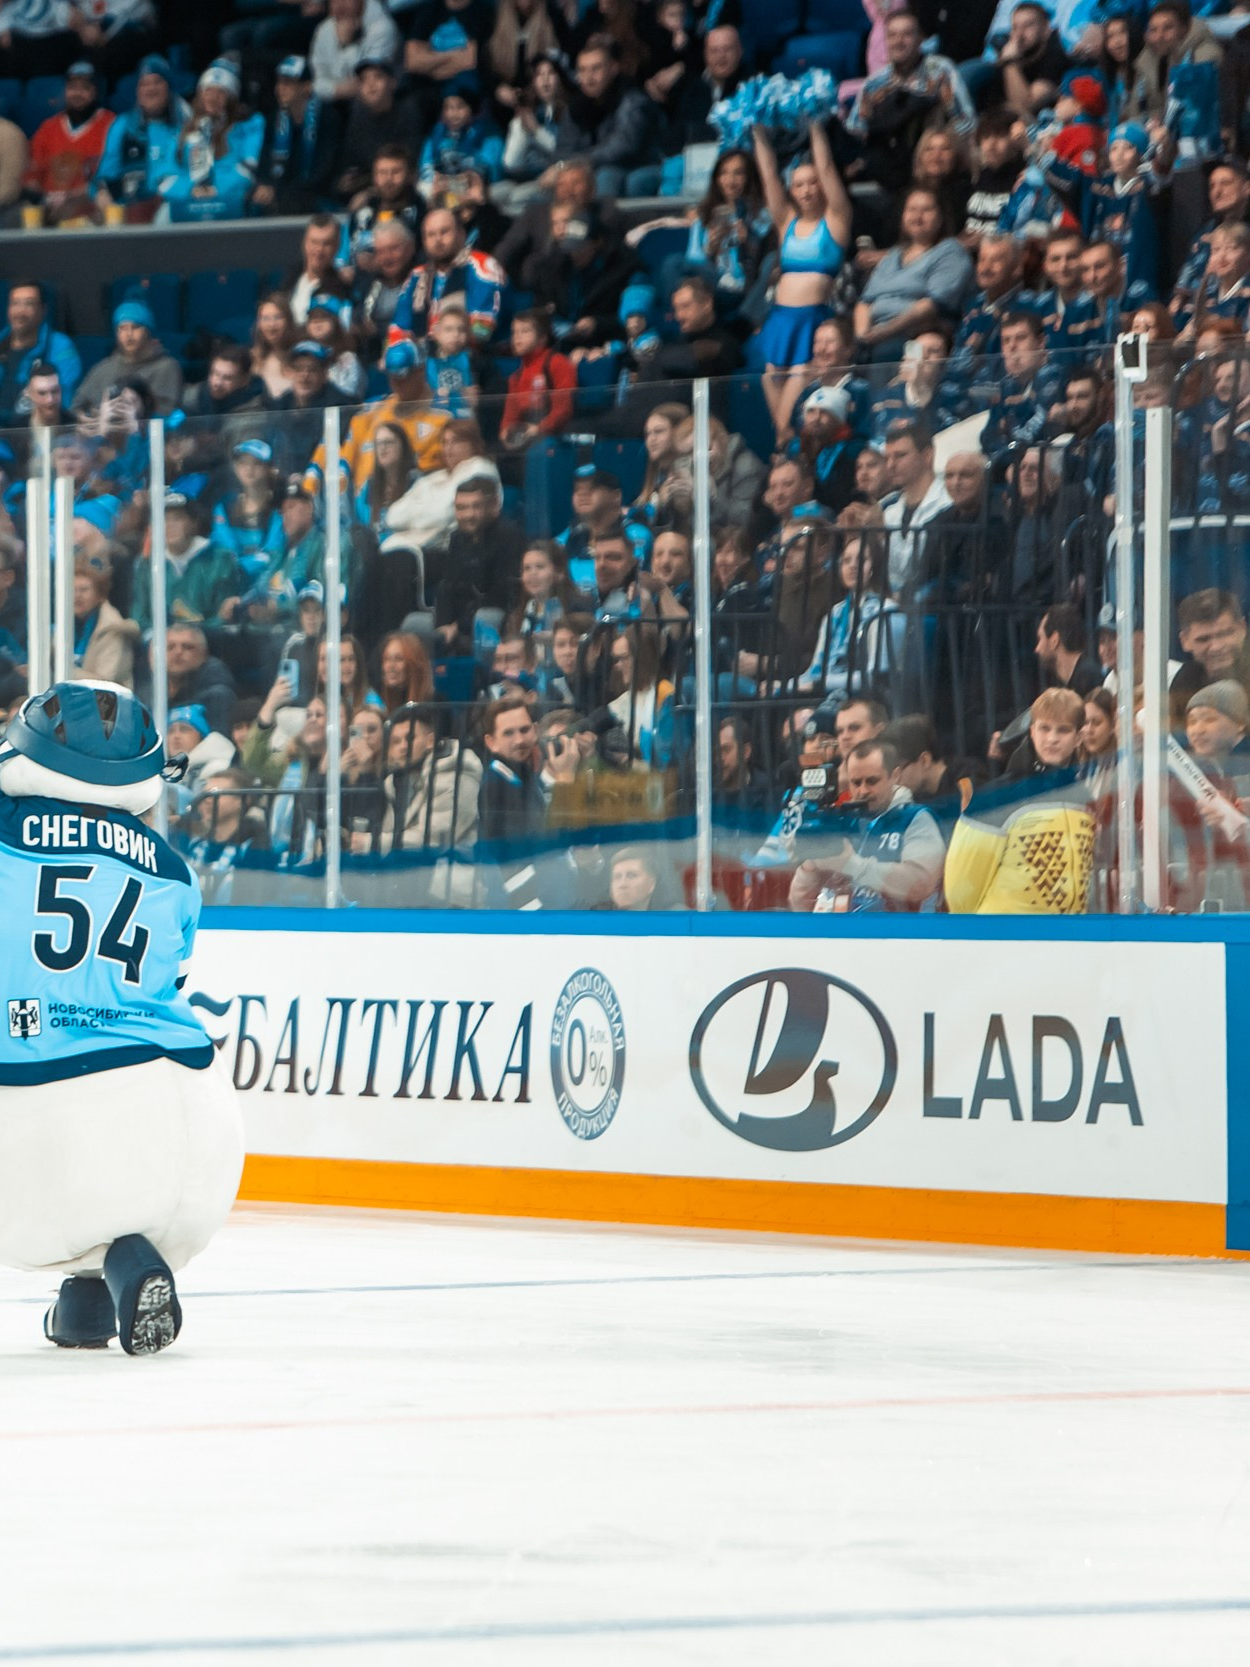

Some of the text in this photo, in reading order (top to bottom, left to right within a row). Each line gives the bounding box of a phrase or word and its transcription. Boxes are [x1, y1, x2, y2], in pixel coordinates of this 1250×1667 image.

[22, 814, 158, 874] СНЕГОВИК
[879, 832, 901, 850] 78
[31, 863, 150, 988] 54
[233, 994, 534, 1104] БАЛТИКА
[923, 1012, 1145, 1127] LADA
[558, 1087, 619, 1140] ПРОДУКЦИЯ
